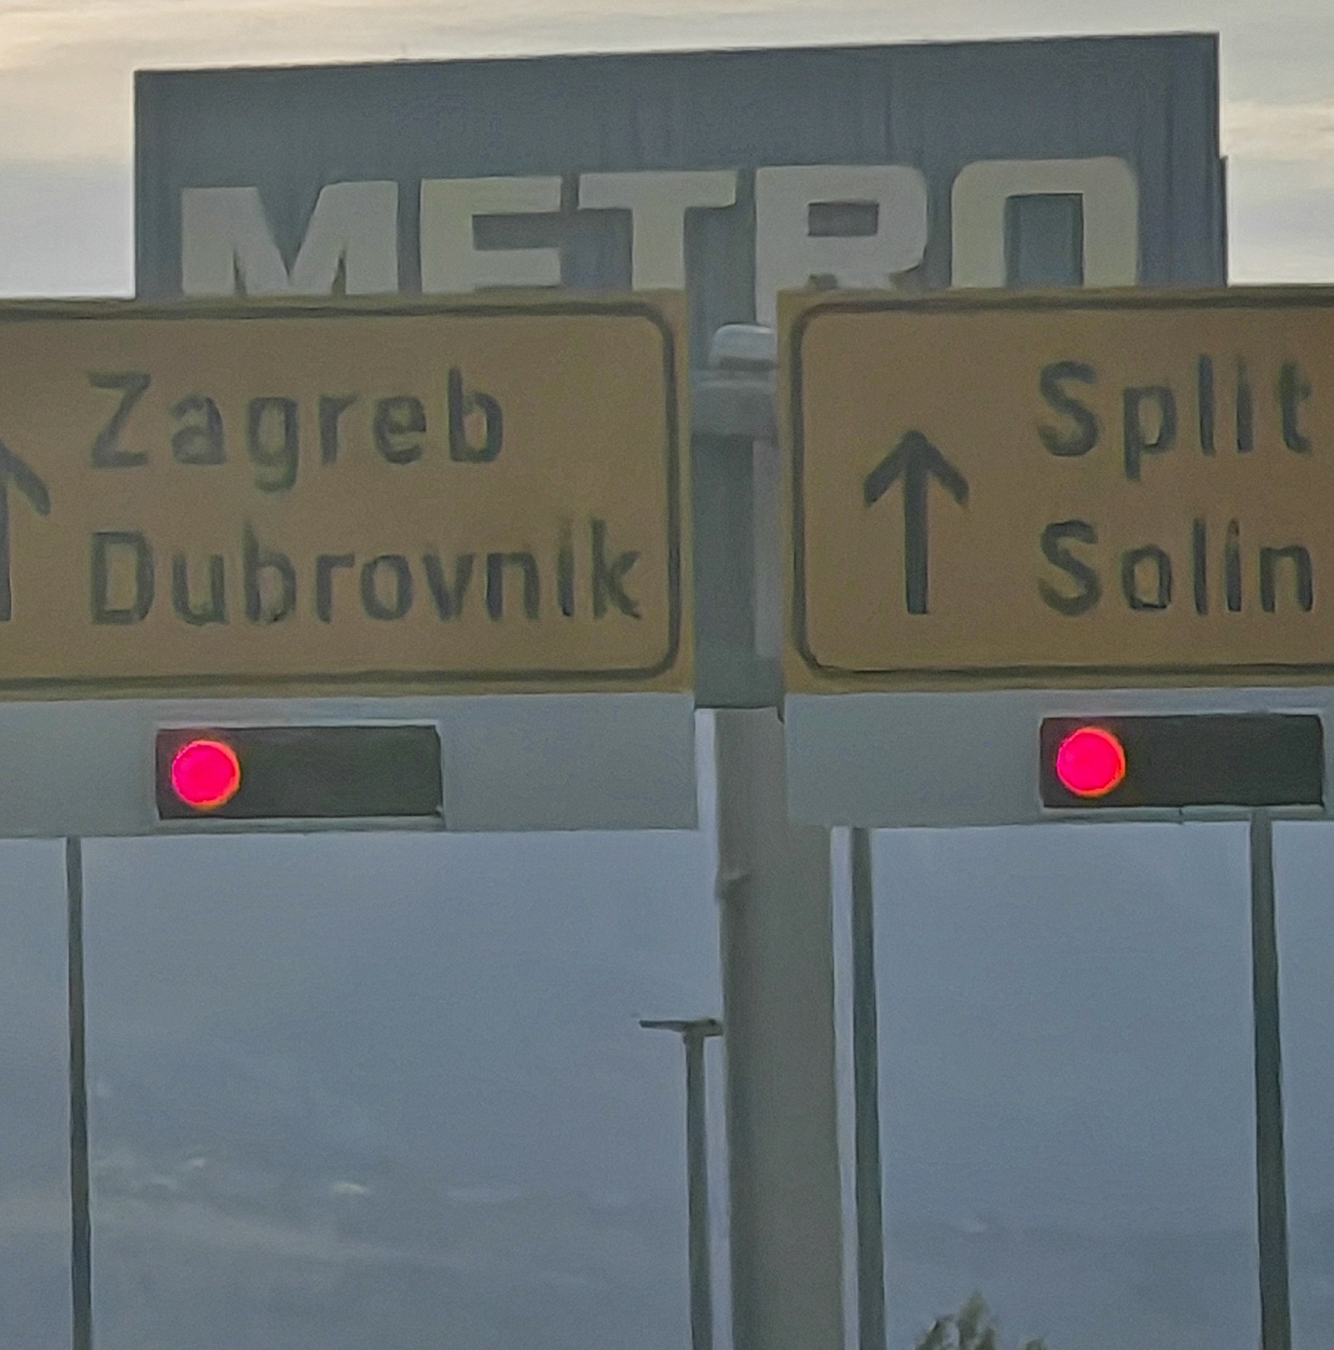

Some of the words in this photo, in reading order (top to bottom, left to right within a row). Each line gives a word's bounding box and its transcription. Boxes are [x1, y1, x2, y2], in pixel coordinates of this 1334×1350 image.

[88, 367, 505, 491] Zagreb
[1037, 354, 1313, 481] Split
[90, 517, 643, 626] Dubrovnik
[1038, 517, 1315, 616] Solin
